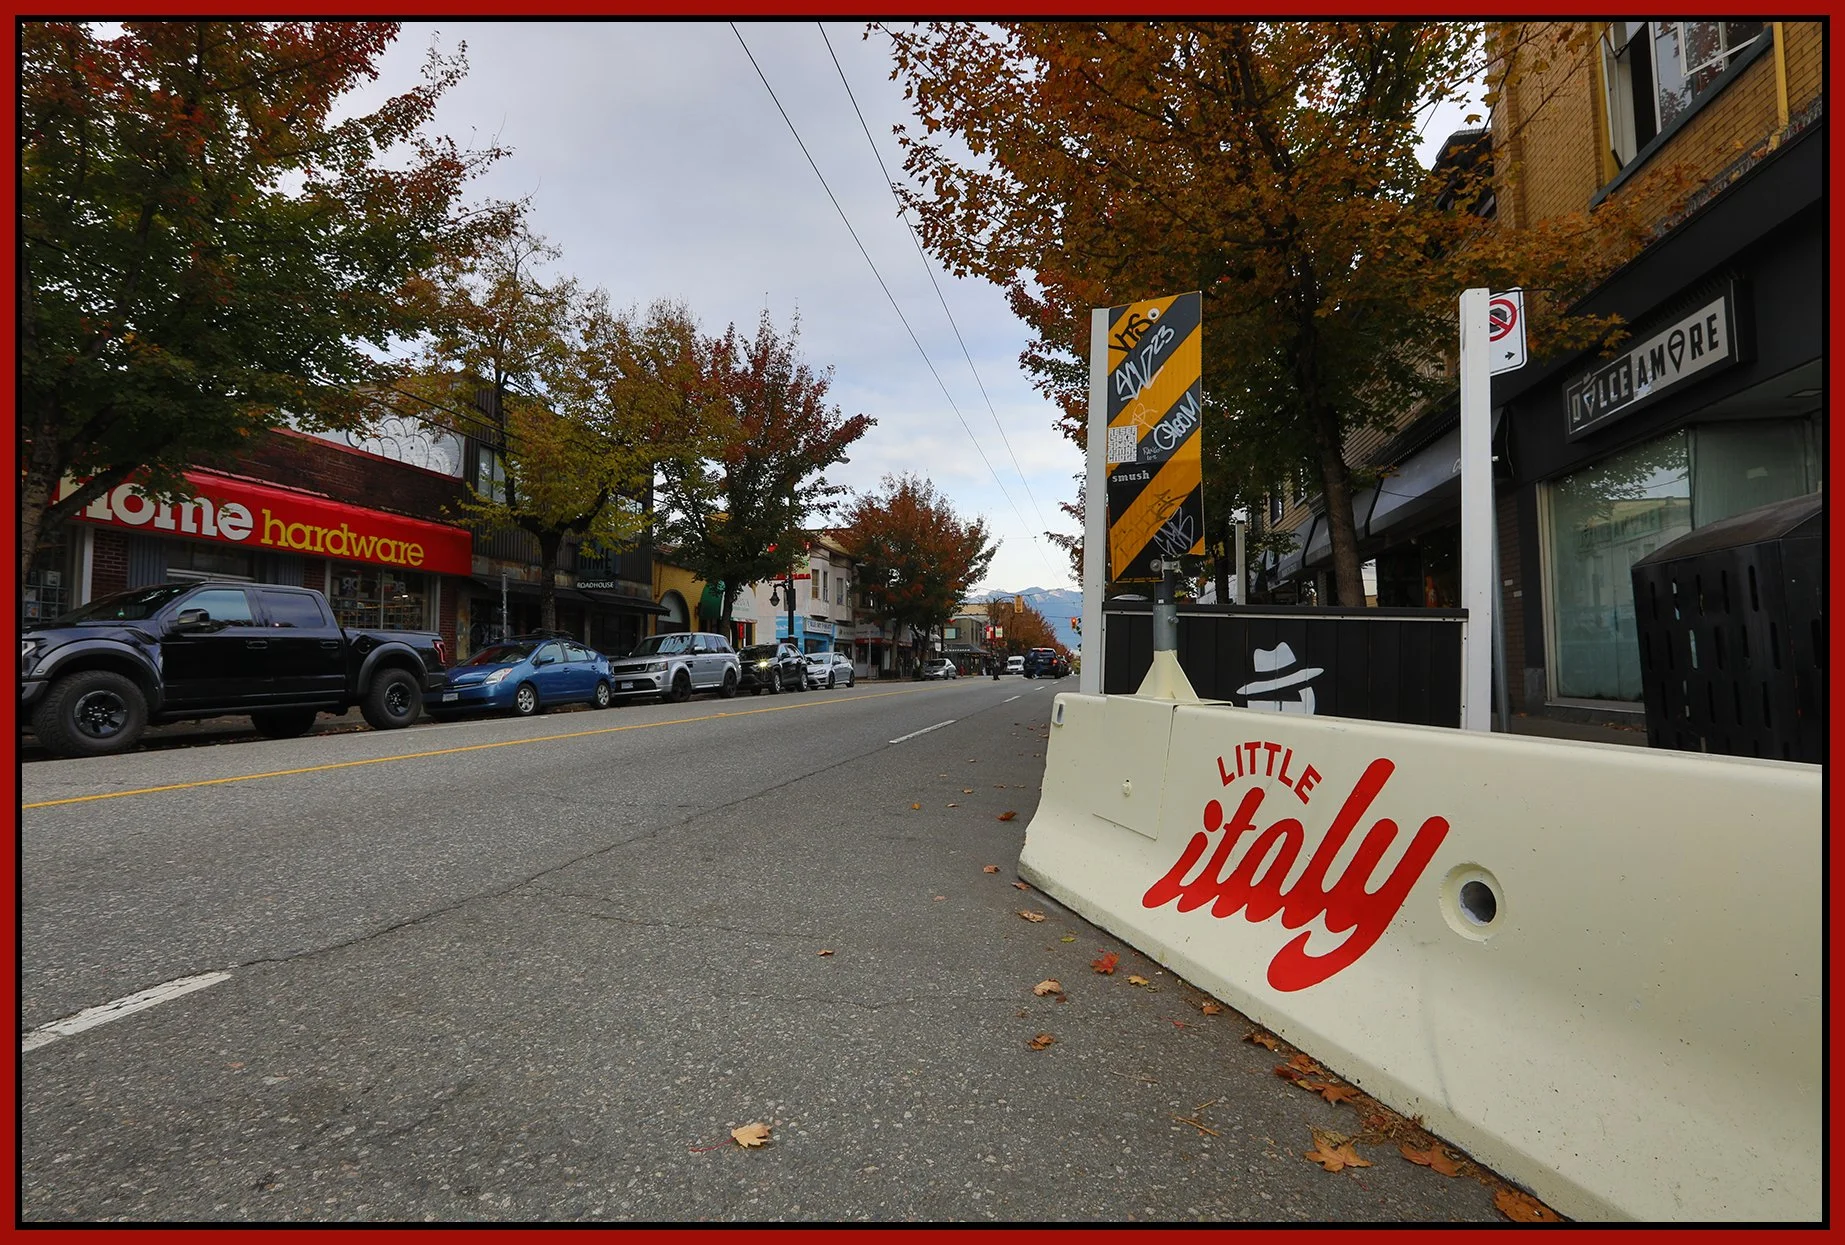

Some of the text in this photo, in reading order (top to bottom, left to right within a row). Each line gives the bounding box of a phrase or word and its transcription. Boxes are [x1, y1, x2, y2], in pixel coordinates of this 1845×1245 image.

[1636, 312, 1720, 389] AMORE
[1112, 470, 1150, 483] smush
[260, 508, 424, 567] hardware
[576, 580, 615, 590] ROADHOUSE
[1216, 740, 1323, 805] LITTLE
[1141, 757, 1450, 993] italy
